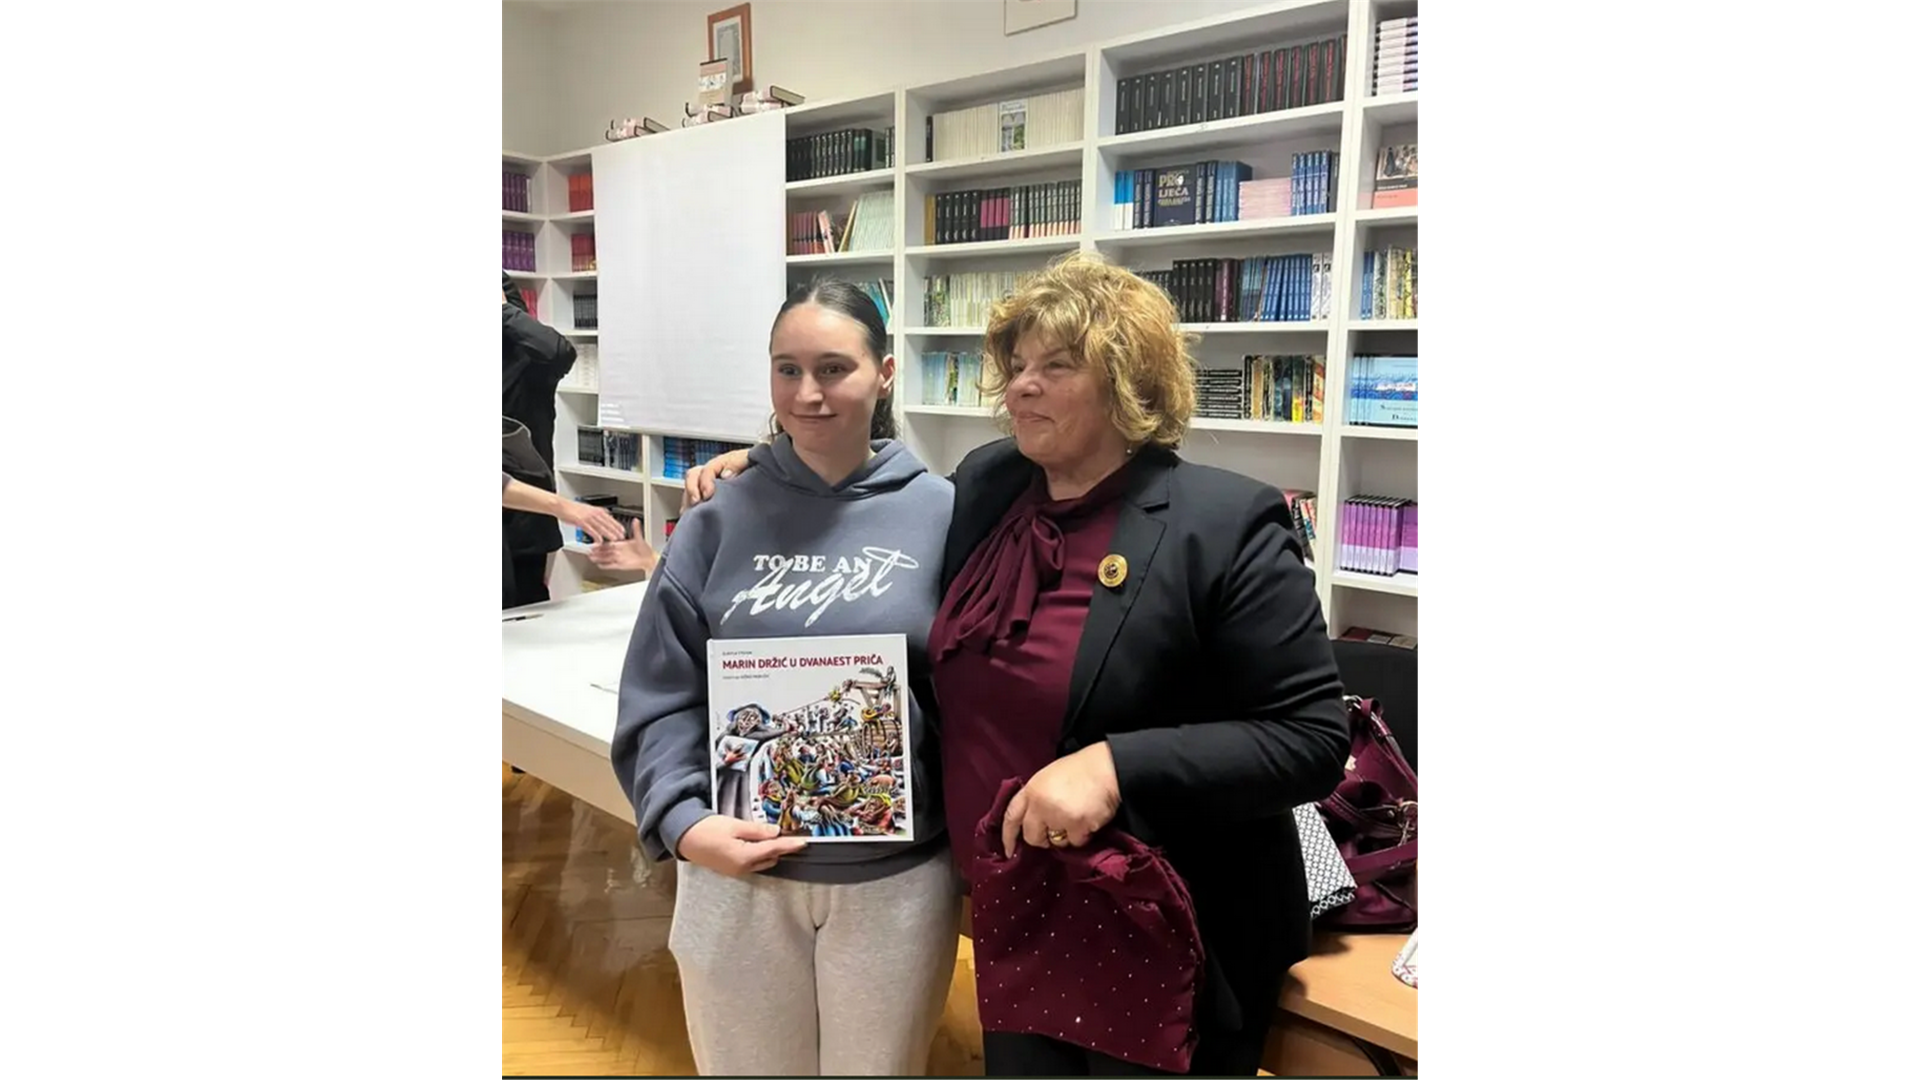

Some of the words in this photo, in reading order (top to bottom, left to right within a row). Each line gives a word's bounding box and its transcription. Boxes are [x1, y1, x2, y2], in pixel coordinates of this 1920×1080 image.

[753, 554, 786, 572] TO
[792, 555, 826, 573] BE
[832, 555, 872, 574] AN
[722, 658, 756, 670] MARIN
[758, 656, 788, 669] DRŽIĆ
[790, 657, 797, 668] U
[799, 655, 851, 668] DVANAEST
[853, 653, 884, 666] PRIČA
